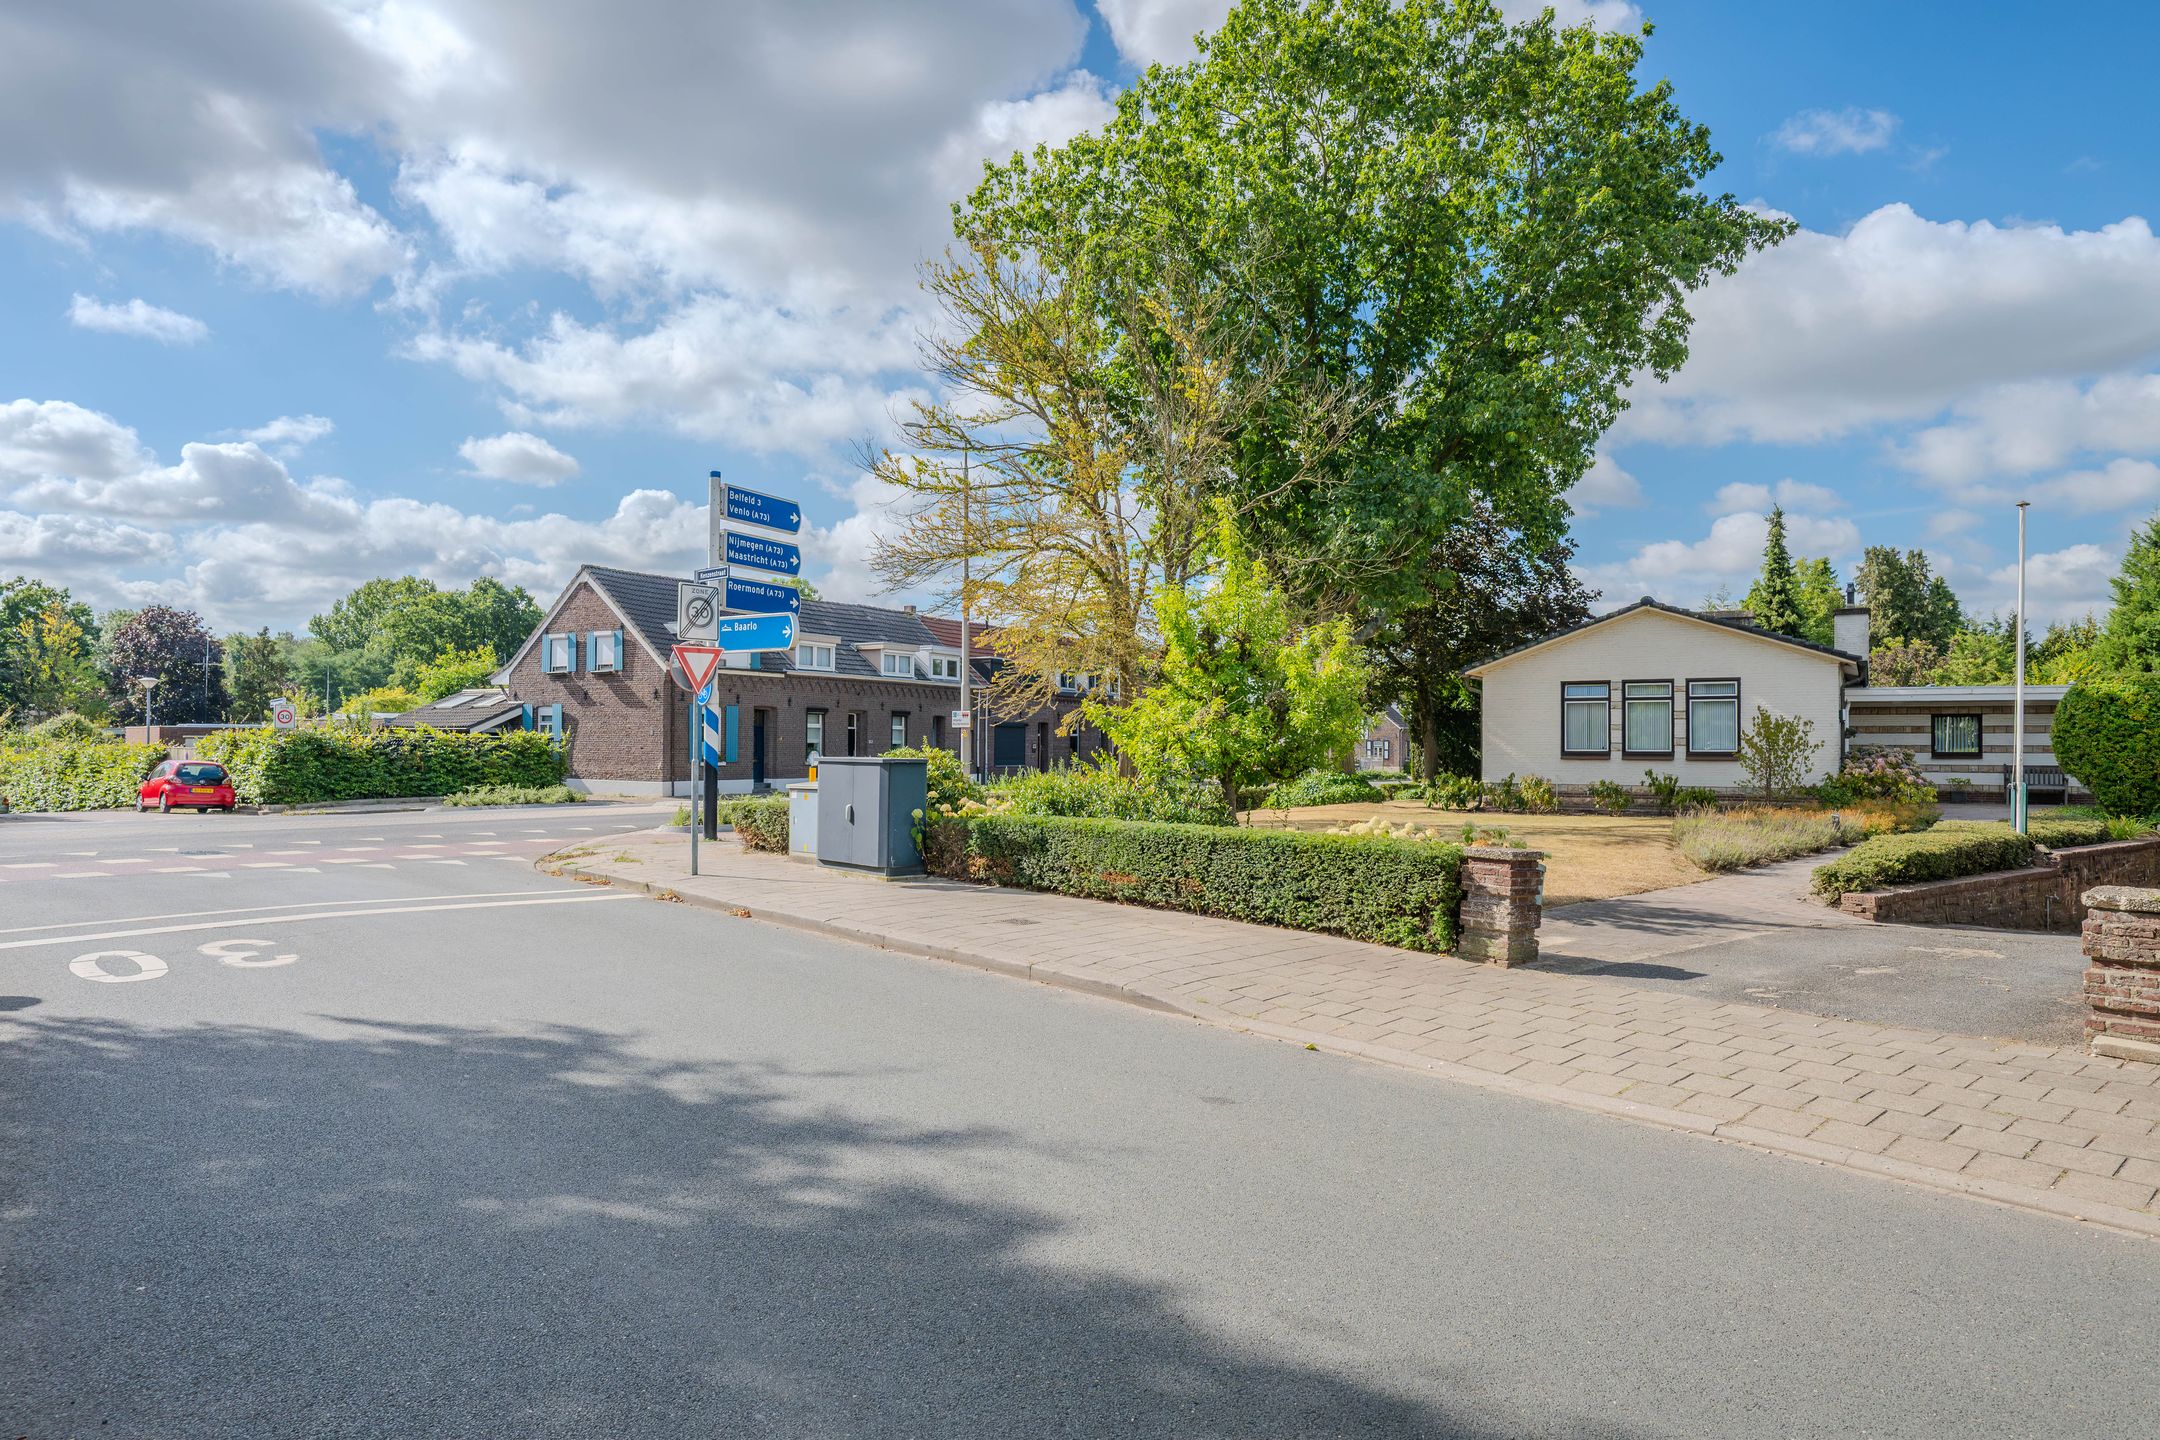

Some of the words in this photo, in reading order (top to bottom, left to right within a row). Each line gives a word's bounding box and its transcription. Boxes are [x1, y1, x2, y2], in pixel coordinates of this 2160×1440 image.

[730, 490, 756, 505] Belfeld
[729, 504, 750, 517] Venlo
[729, 536, 764, 551] Nijmegen
[728, 550, 769, 565] Maastricht
[728, 581, 765, 595] Roermond
[734, 621, 758, 631] Baarlo
